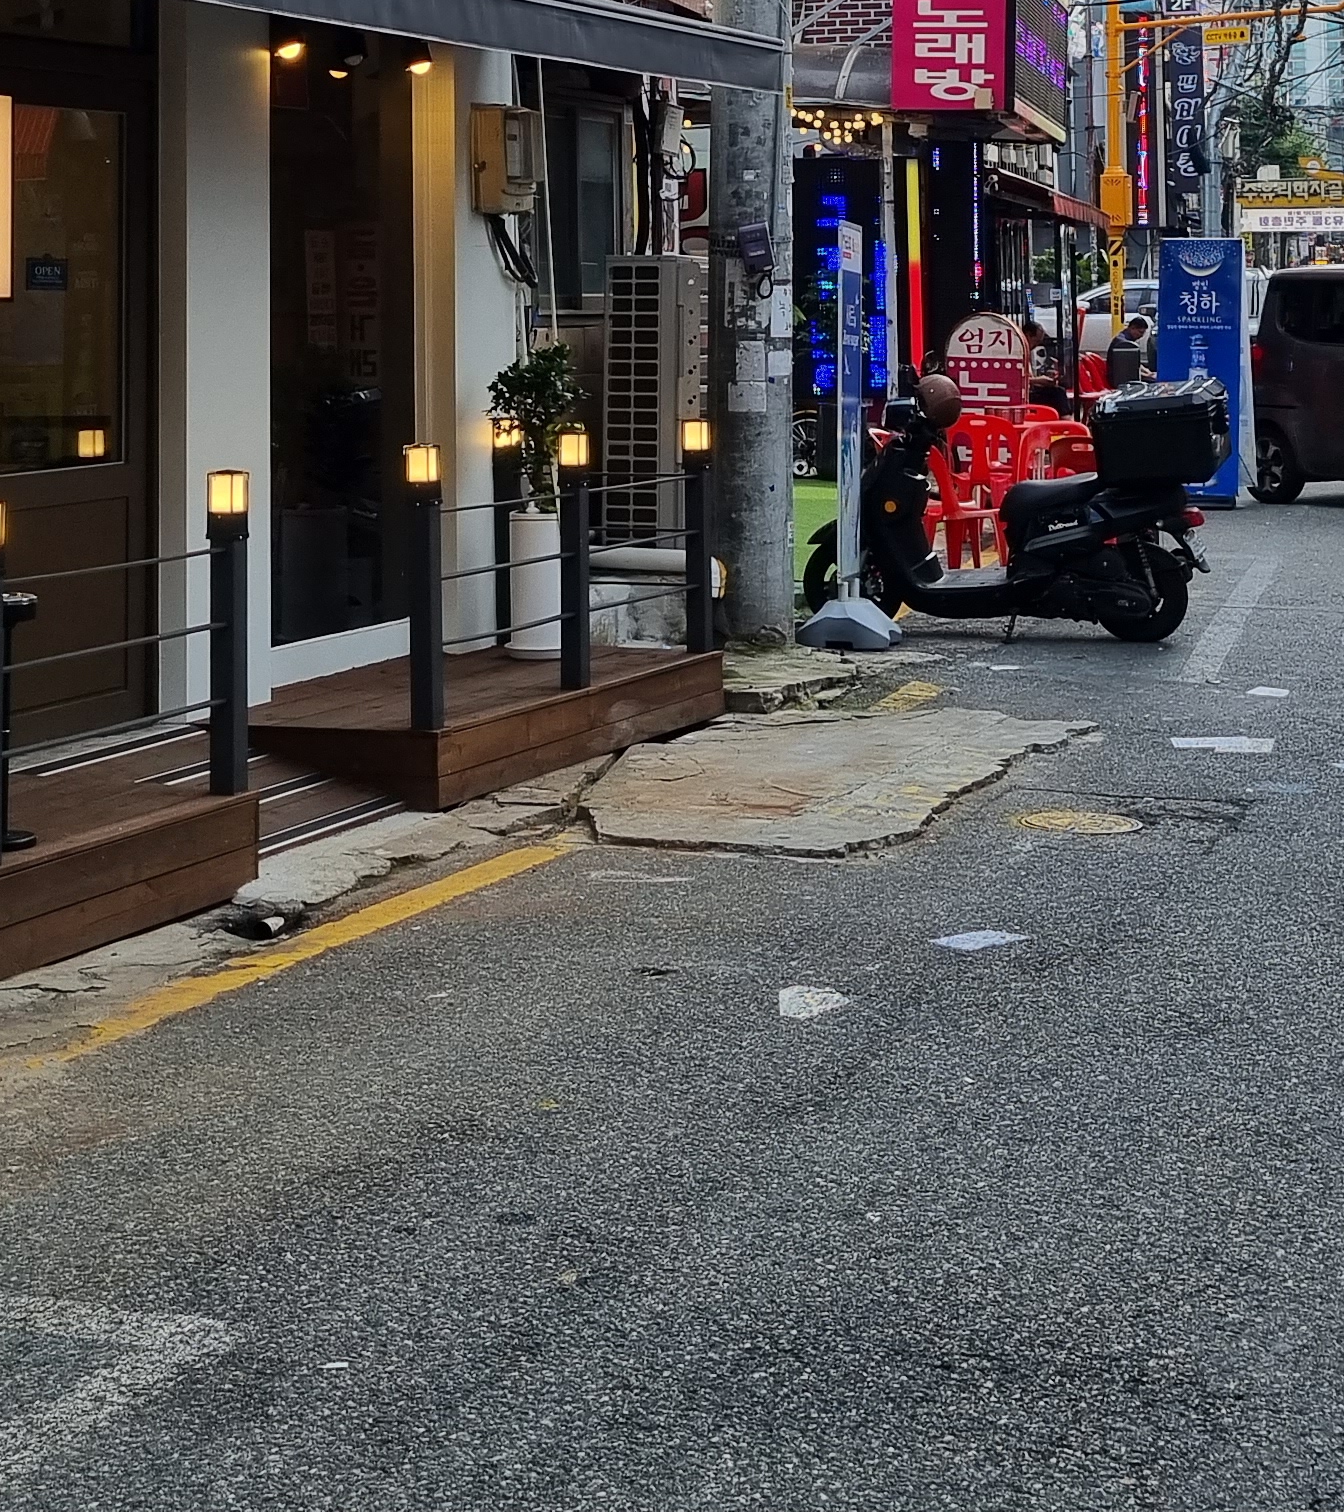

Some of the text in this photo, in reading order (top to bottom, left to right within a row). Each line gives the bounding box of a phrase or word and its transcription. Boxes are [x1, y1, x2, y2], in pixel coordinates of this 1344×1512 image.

[912, 0, 996, 102] 노래방
[34, 266, 61, 276] OPEN
[1179, 291, 1220, 315] 청하
[958, 328, 1013, 355] 엄지
